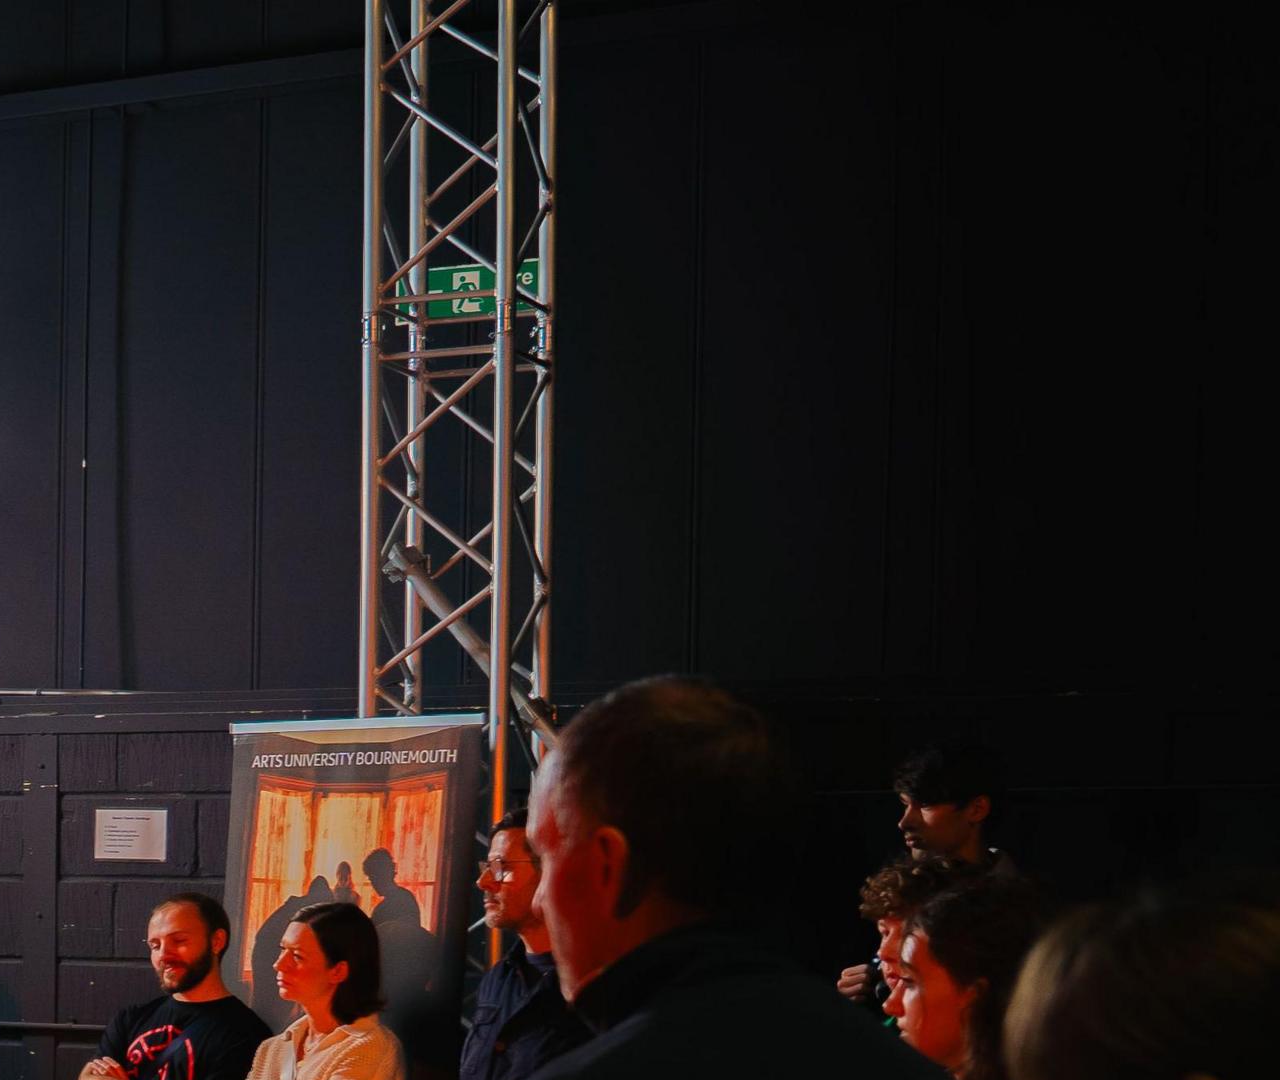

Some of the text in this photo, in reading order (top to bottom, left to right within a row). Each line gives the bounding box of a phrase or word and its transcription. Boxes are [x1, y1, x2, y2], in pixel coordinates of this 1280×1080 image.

[252, 749, 458, 768] ARTS UNIVERSITY BOURNEMOUTH
